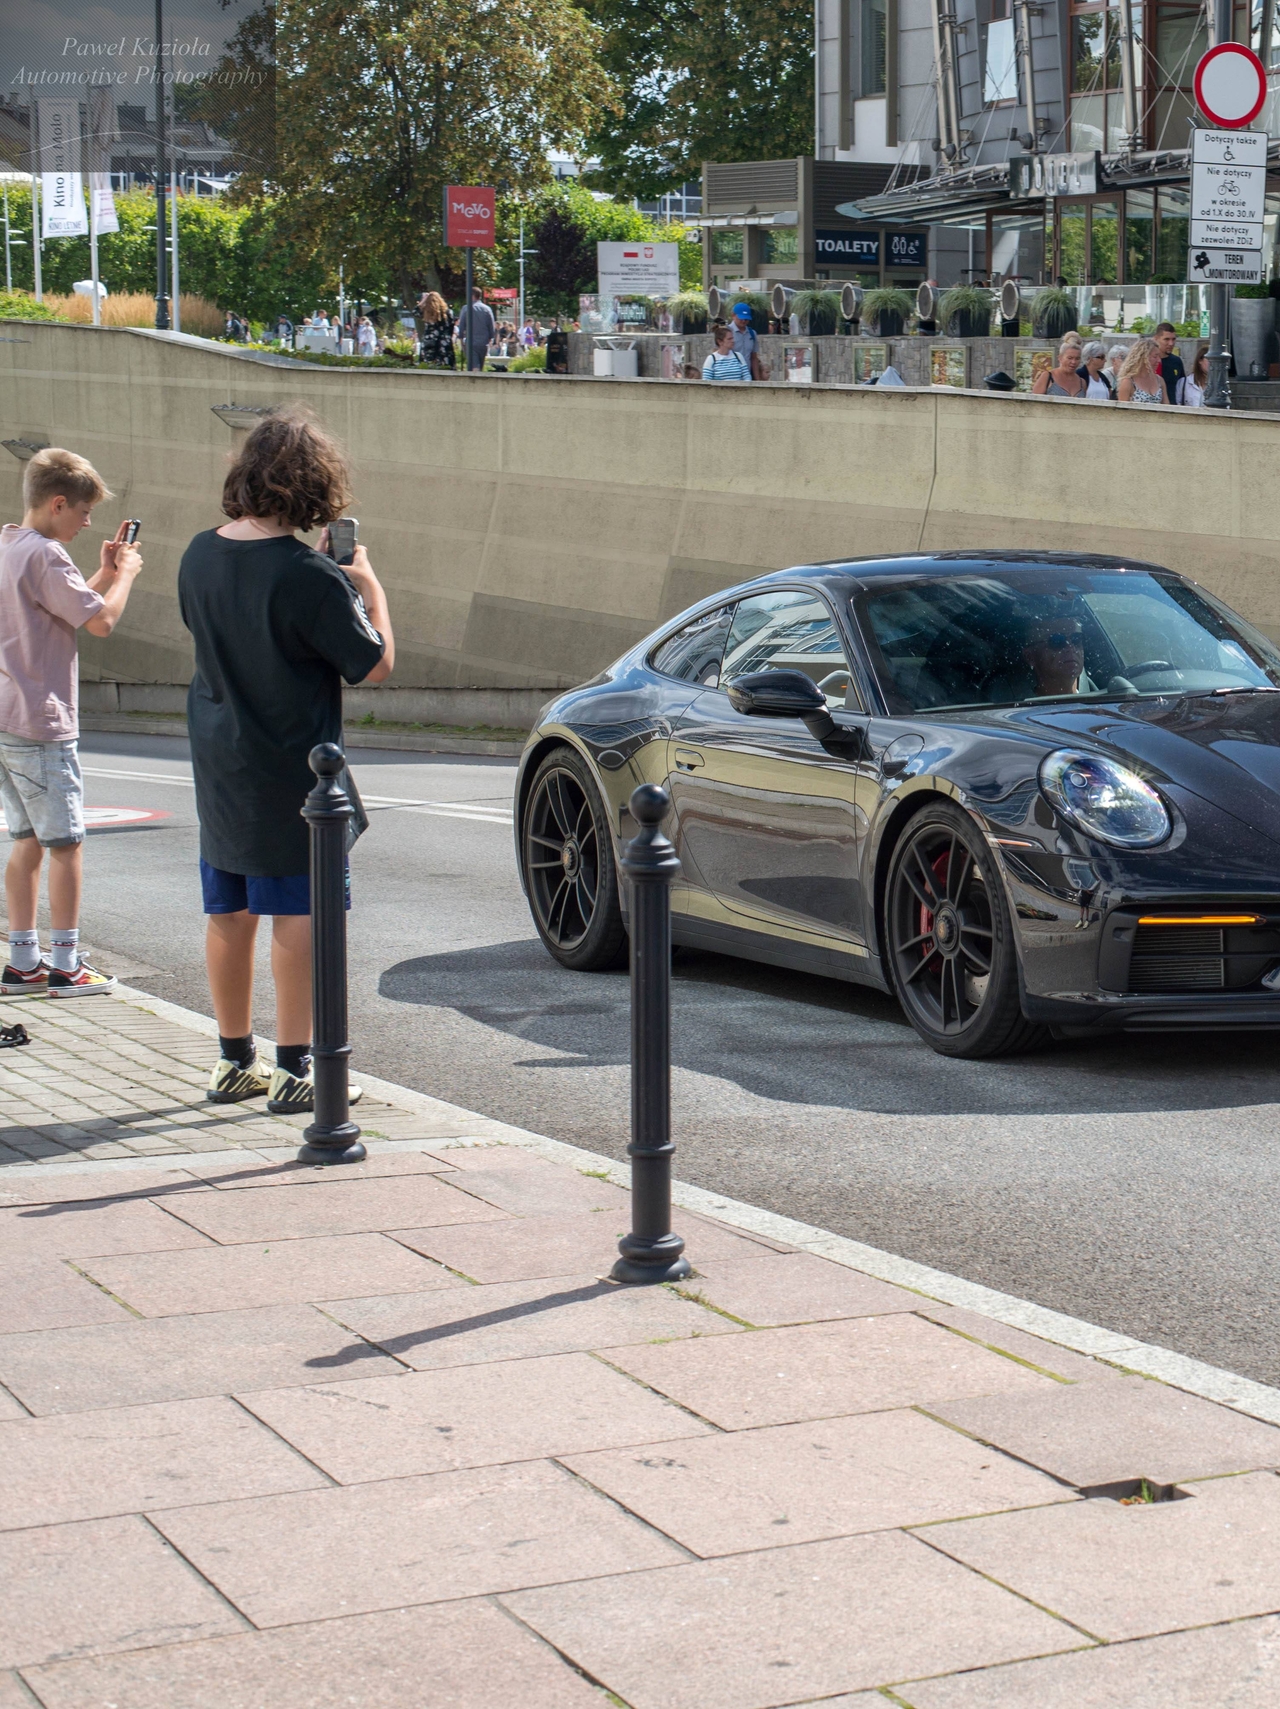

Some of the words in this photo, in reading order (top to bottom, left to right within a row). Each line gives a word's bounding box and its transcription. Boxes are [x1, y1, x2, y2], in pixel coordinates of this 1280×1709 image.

[51, 113, 62, 149] Molo
[1204, 133, 1234, 145] Dotyczy
[1236, 136, 1257, 145] także
[55, 155, 64, 172] na
[1207, 167, 1220, 175] Nie
[1223, 168, 1252, 179] dotyczy
[53, 176, 65, 208] Kino
[1219, 198, 1246, 207] okresie
[1206, 224, 1219, 232] Nie
[1221, 225, 1249, 235] dotyczy
[816, 239, 879, 252] TOALETY
[1201, 236, 1235, 244] zezwoleń
[1224, 254, 1244, 264] TEREN
[1209, 269, 1259, 280] MONITOROWANY
[217, 1067, 262, 1093] NIKE
[274, 1076, 315, 1101] NIK
